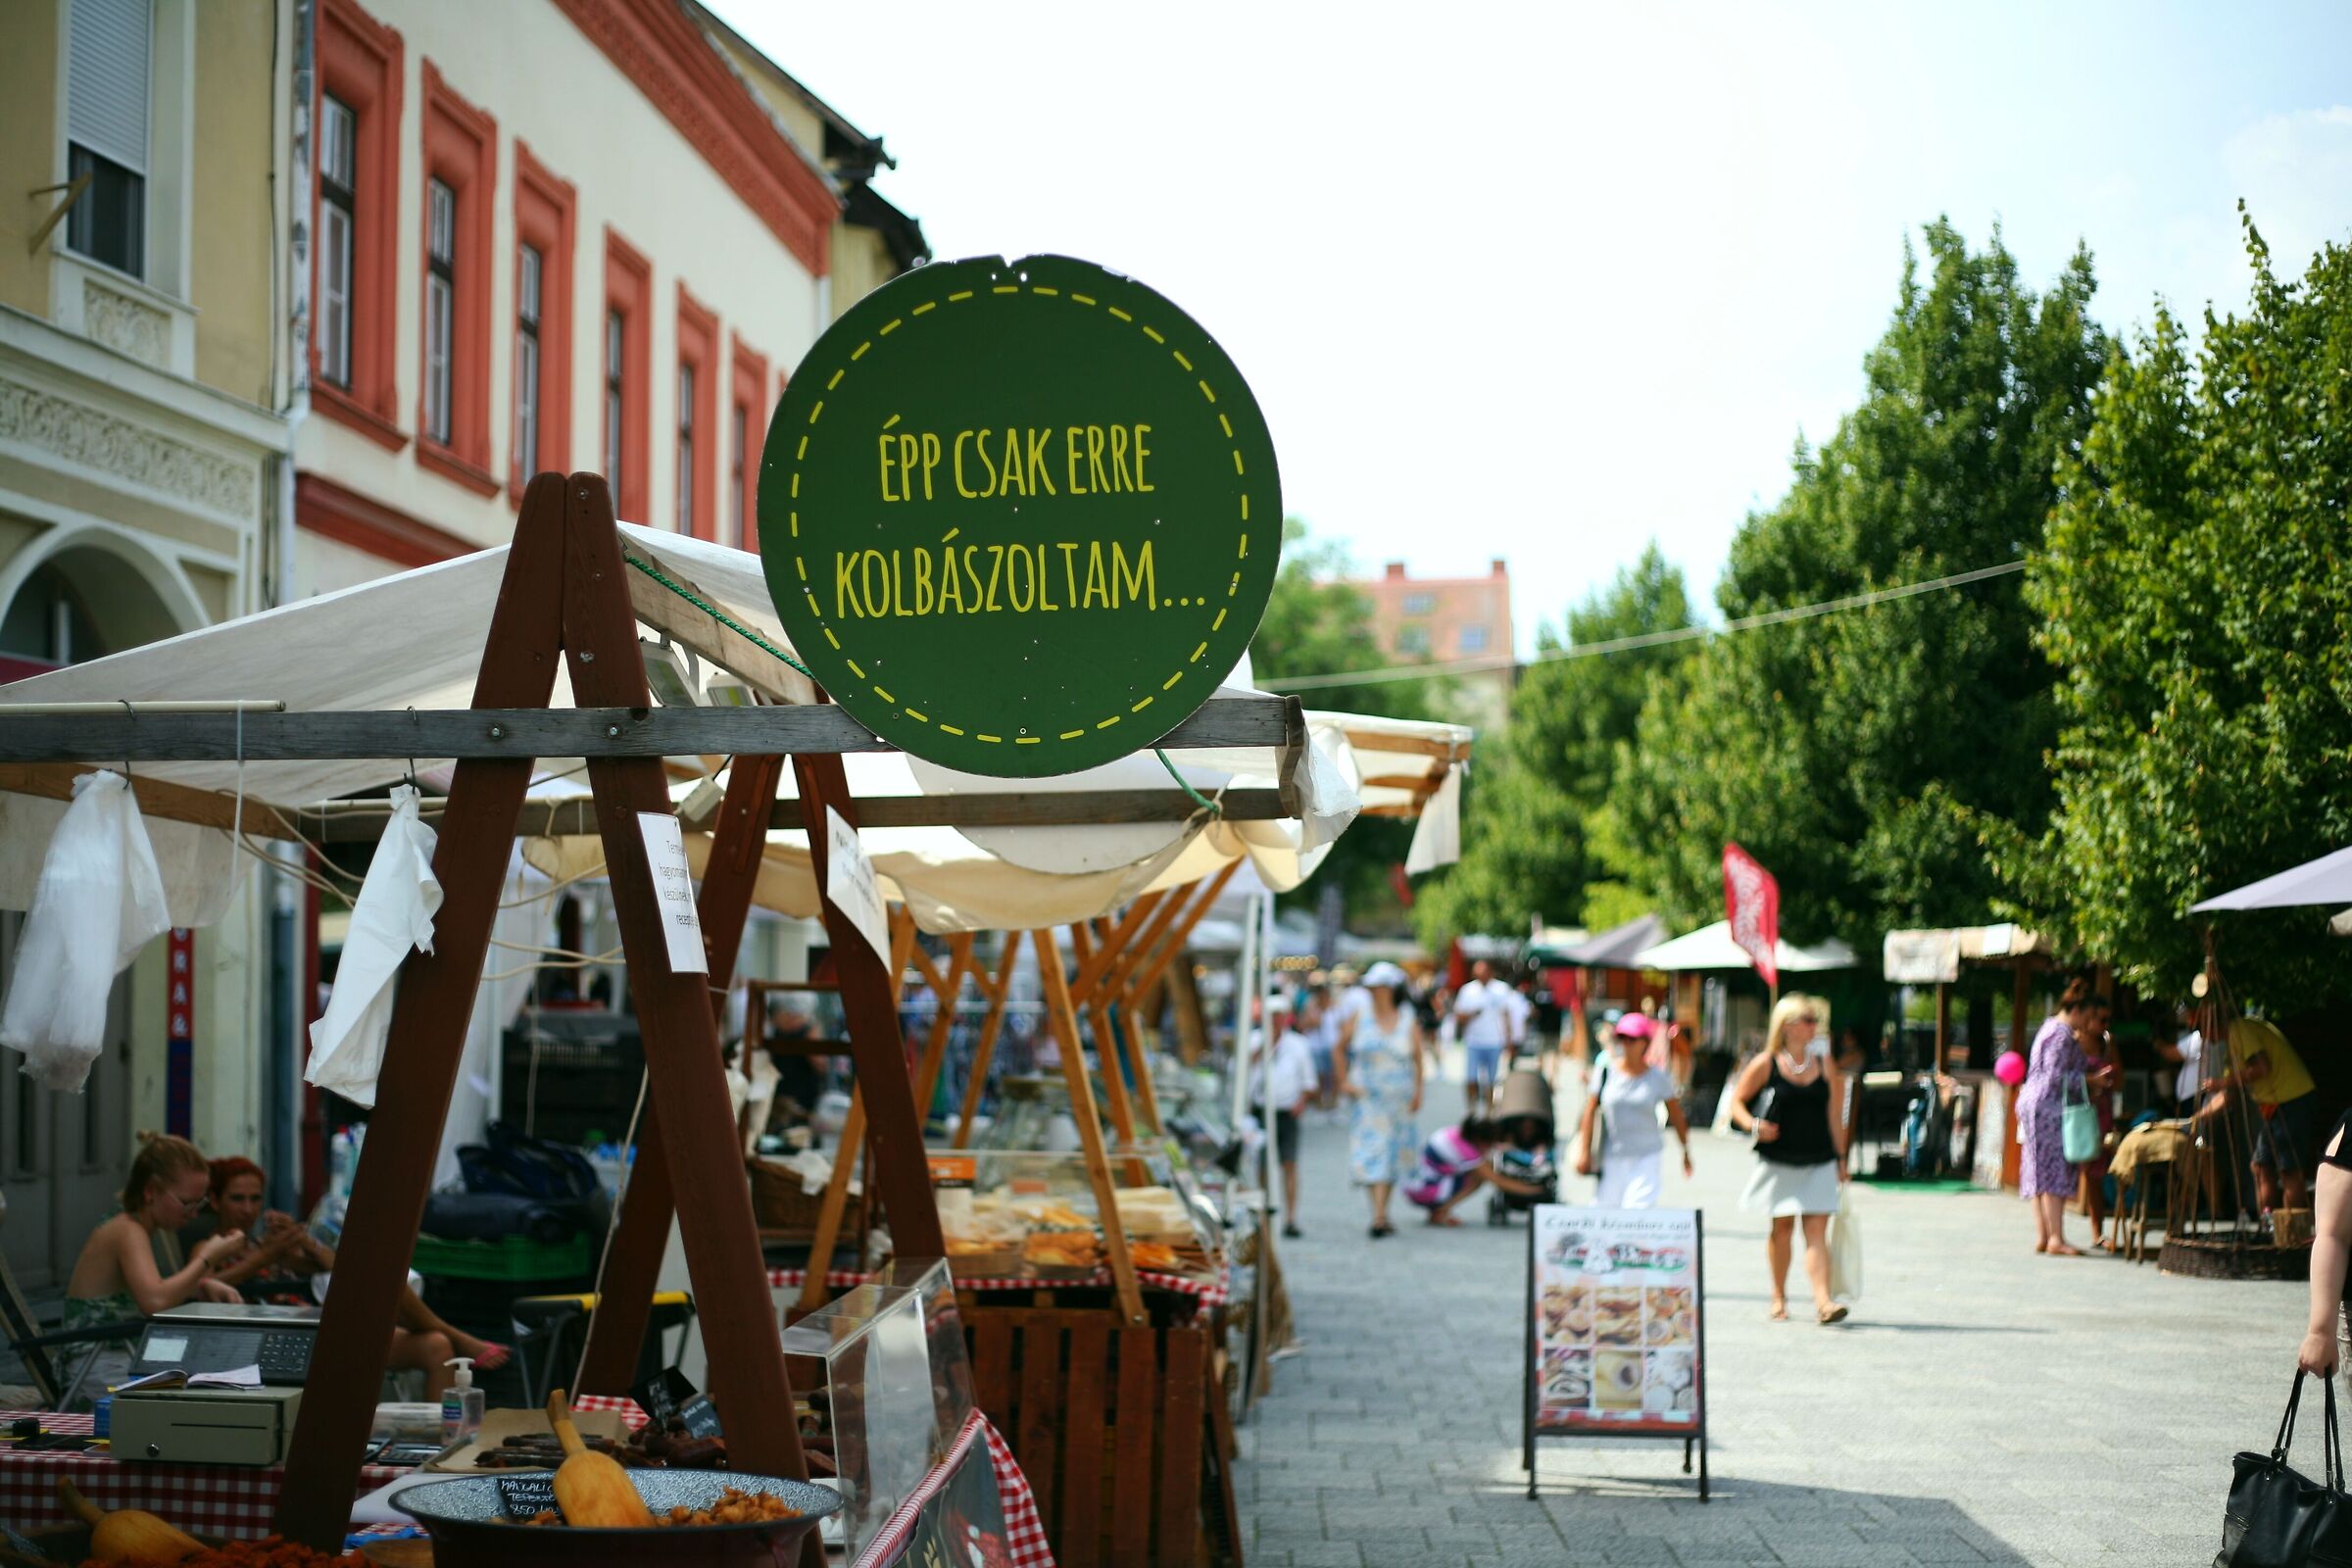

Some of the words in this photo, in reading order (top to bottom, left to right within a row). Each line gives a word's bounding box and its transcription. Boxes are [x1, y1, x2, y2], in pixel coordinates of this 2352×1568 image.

[879, 414, 942, 502] ÉPP
[954, 427, 1056, 499] CSAK
[1066, 423, 1155, 495] ERRE
[836, 527, 1205, 619] KOLBÁSZOLTAM...
[510, 1503, 535, 1515] 850
